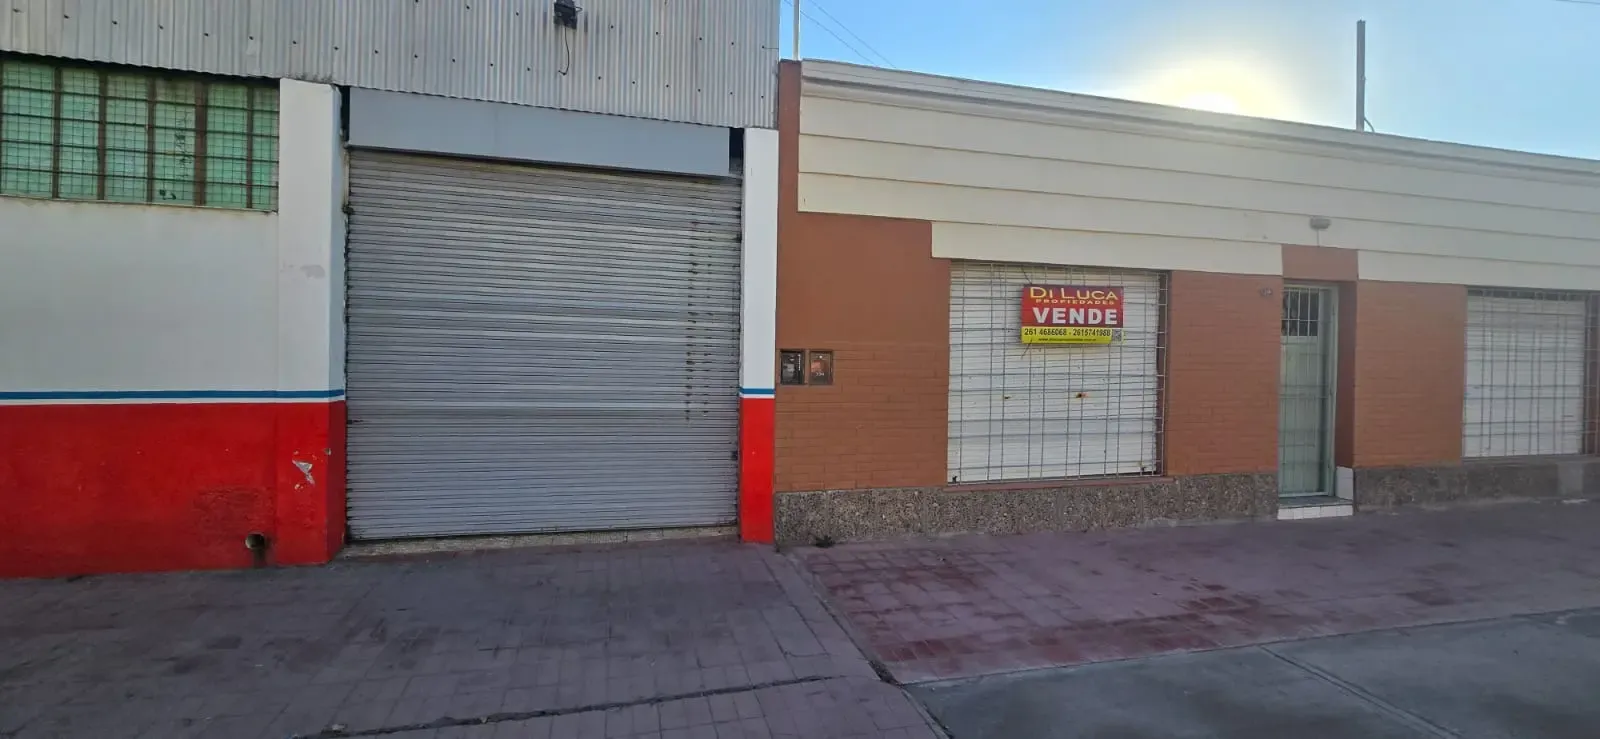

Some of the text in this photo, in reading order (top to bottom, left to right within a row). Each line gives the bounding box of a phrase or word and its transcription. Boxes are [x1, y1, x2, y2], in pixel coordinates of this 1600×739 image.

[1060, 287, 1119, 300] LUCA
[1032, 307, 1118, 325] VENDE
[1024, 328, 1037, 336] 261
